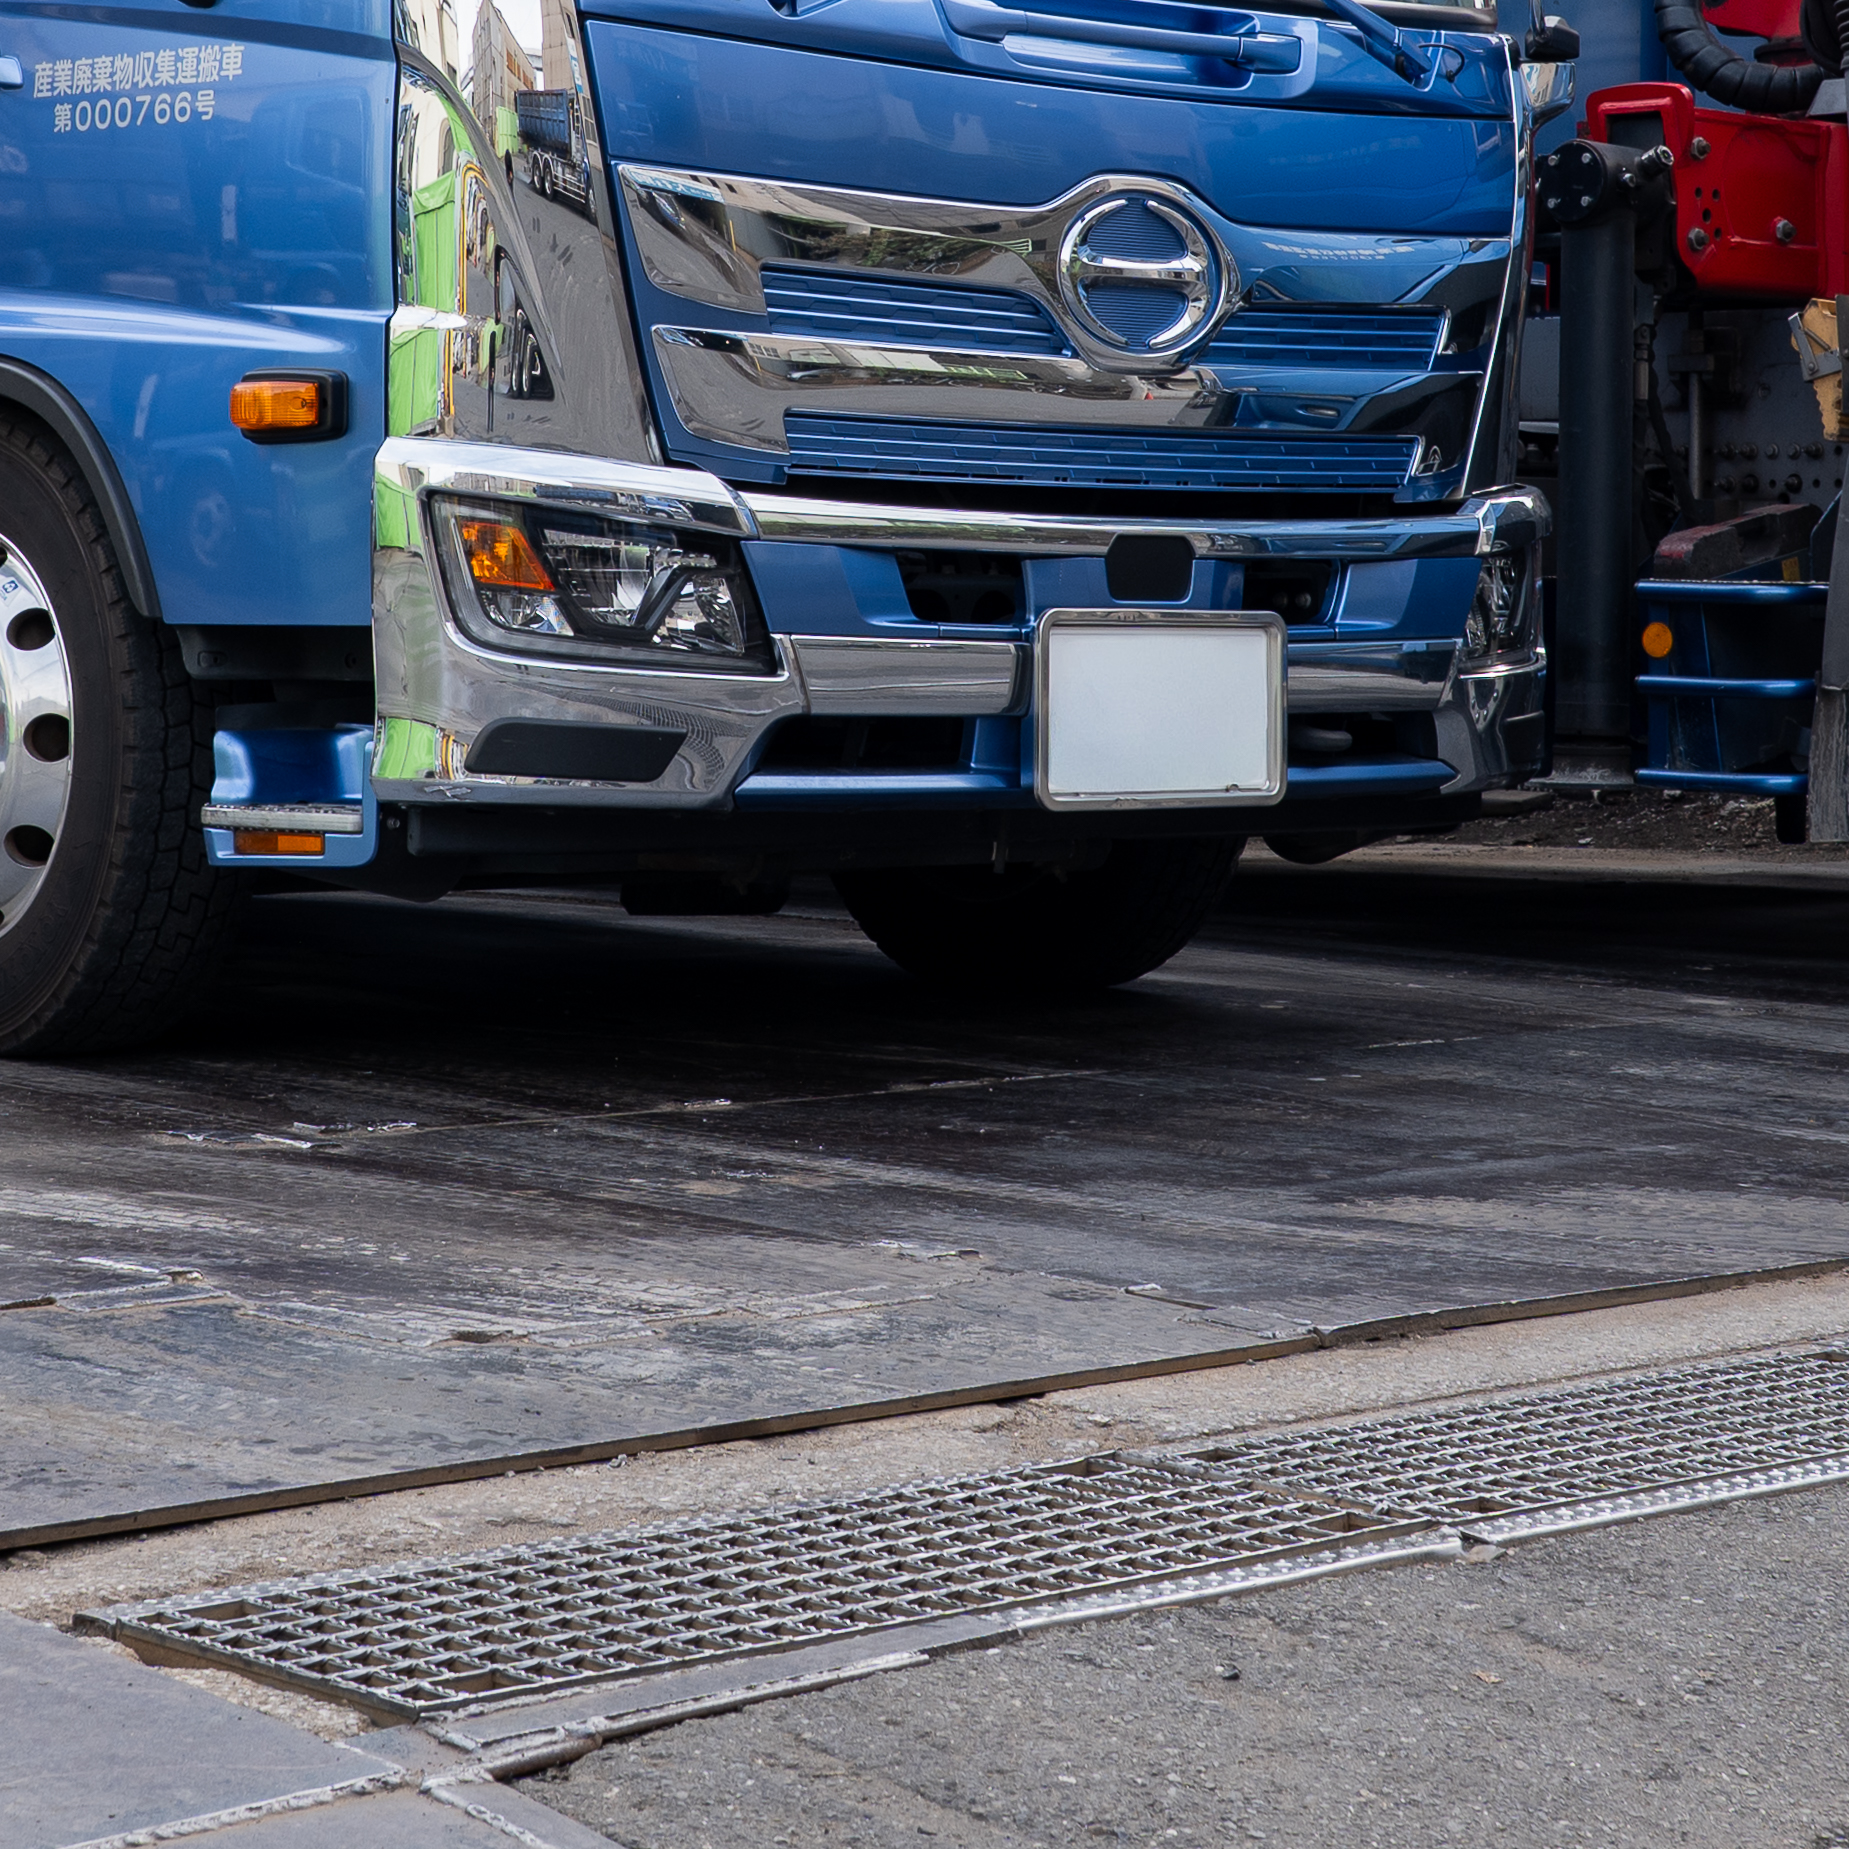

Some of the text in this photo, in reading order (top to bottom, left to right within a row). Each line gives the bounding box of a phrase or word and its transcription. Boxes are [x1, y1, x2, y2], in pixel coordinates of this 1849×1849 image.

[33, 44, 245, 98] 産業廃棄物収集運搬車
[53, 89, 216, 133] 第000766号
